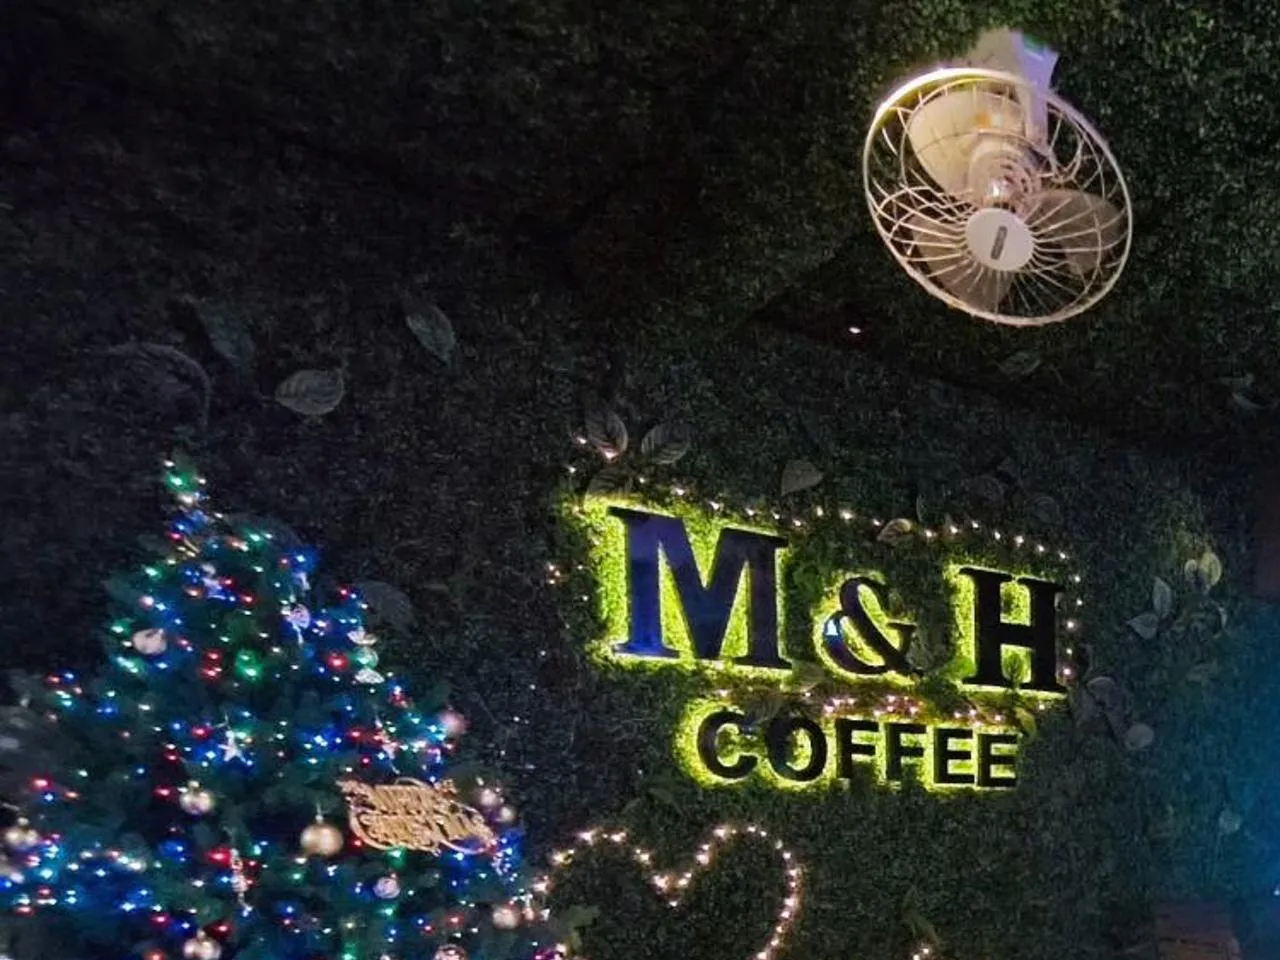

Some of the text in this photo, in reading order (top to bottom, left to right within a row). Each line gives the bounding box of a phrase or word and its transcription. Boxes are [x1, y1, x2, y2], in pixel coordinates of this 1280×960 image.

[608, 506, 1067, 694] M & H
[697, 711, 1019, 787] COFFEE
